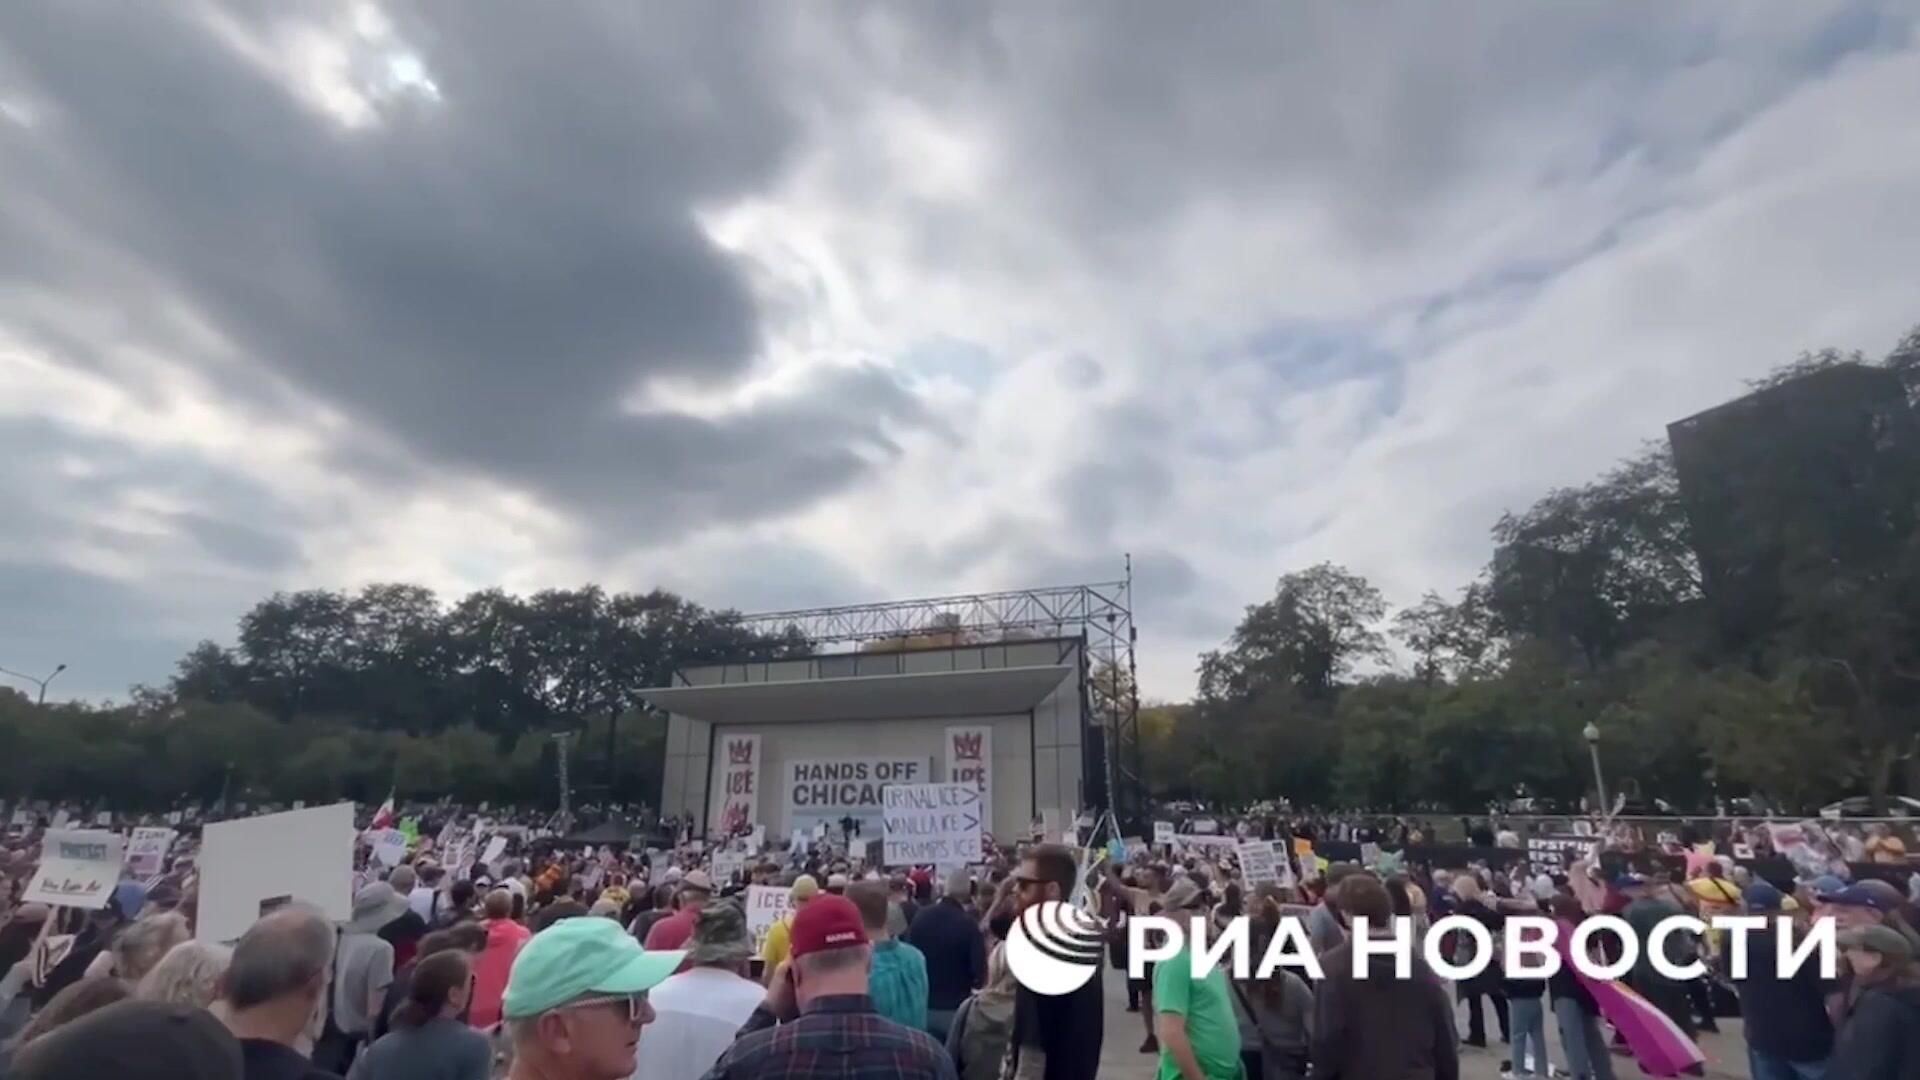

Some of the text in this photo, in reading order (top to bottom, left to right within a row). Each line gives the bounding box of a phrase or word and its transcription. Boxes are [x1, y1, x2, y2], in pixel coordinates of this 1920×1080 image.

[794, 761, 919, 781] HANDS OFF
[792, 782, 888, 806] CHICA
[885, 789, 937, 809] URINAL
[941, 786, 960, 806] ICE
[884, 815, 938, 835] VANILLA
[953, 839, 977, 858] ICE
[756, 892, 782, 909] ICE
